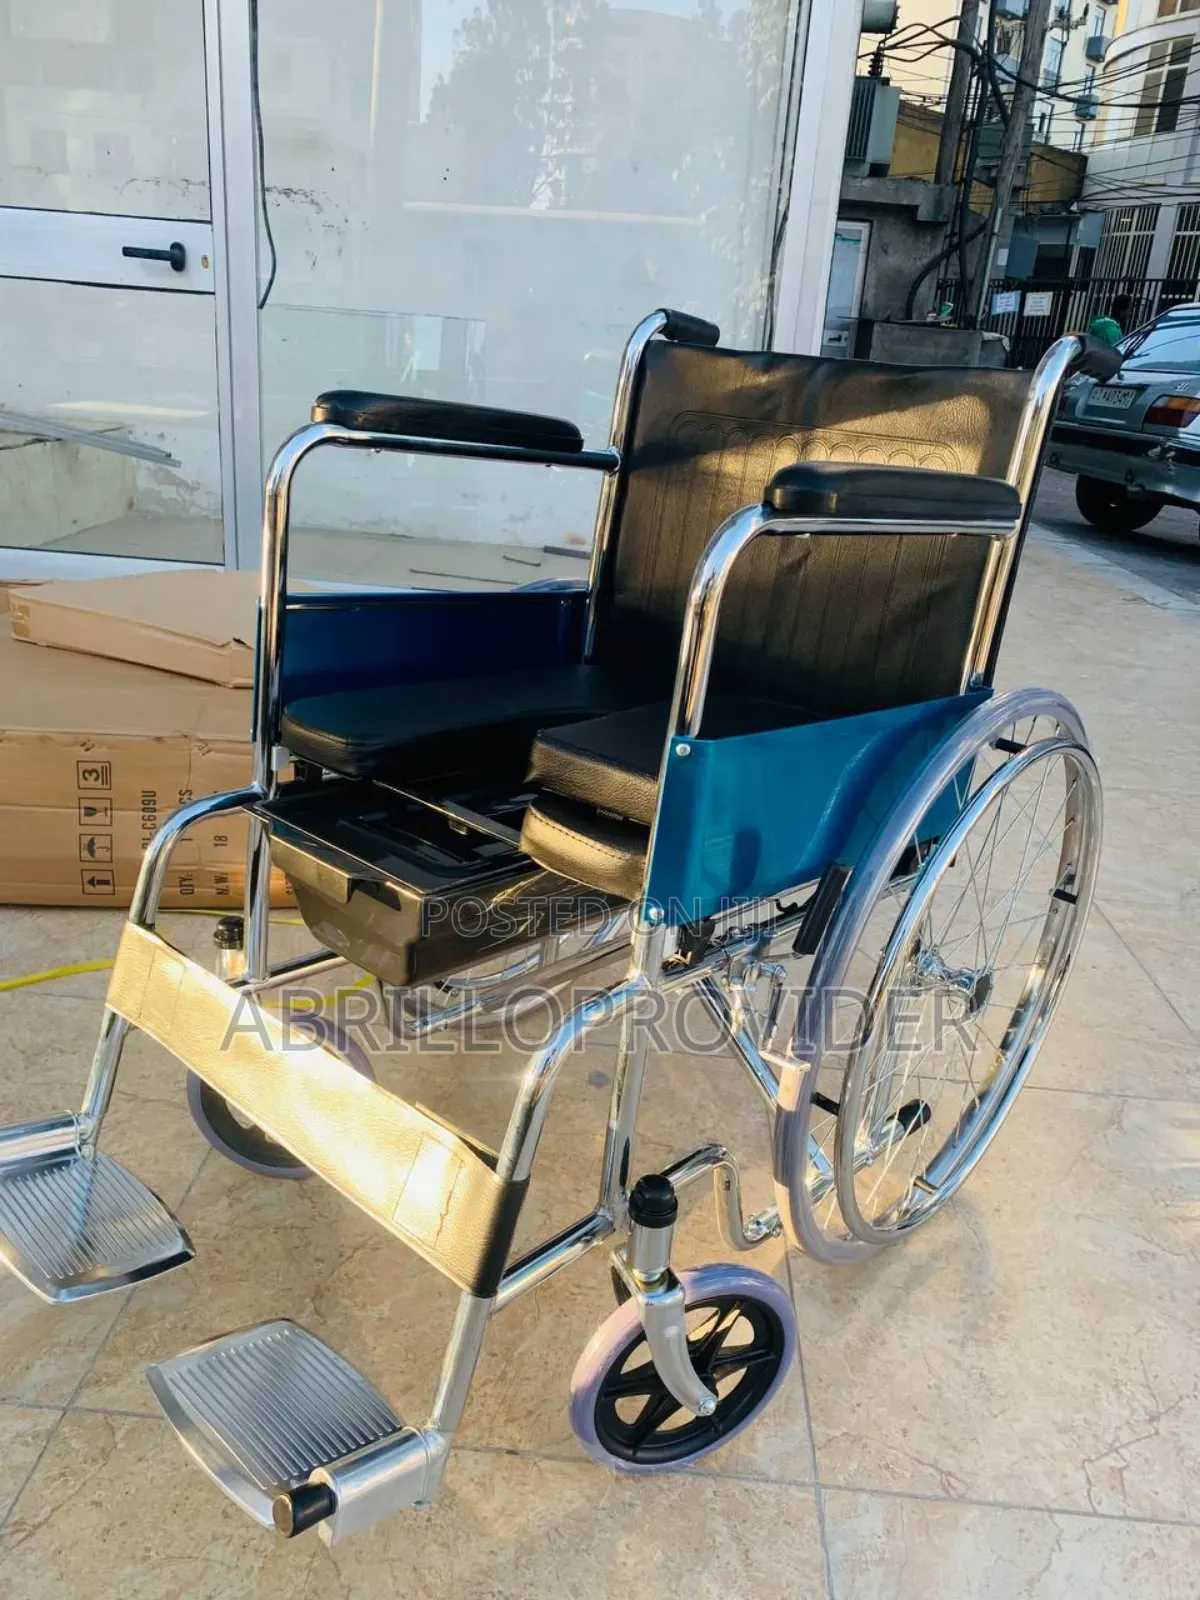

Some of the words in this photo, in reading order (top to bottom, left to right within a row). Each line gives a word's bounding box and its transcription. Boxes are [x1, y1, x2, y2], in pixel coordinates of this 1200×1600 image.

[82, 767, 100, 782] 3
[213, 834, 228, 848] 18
[178, 873, 195, 896] QTY:
